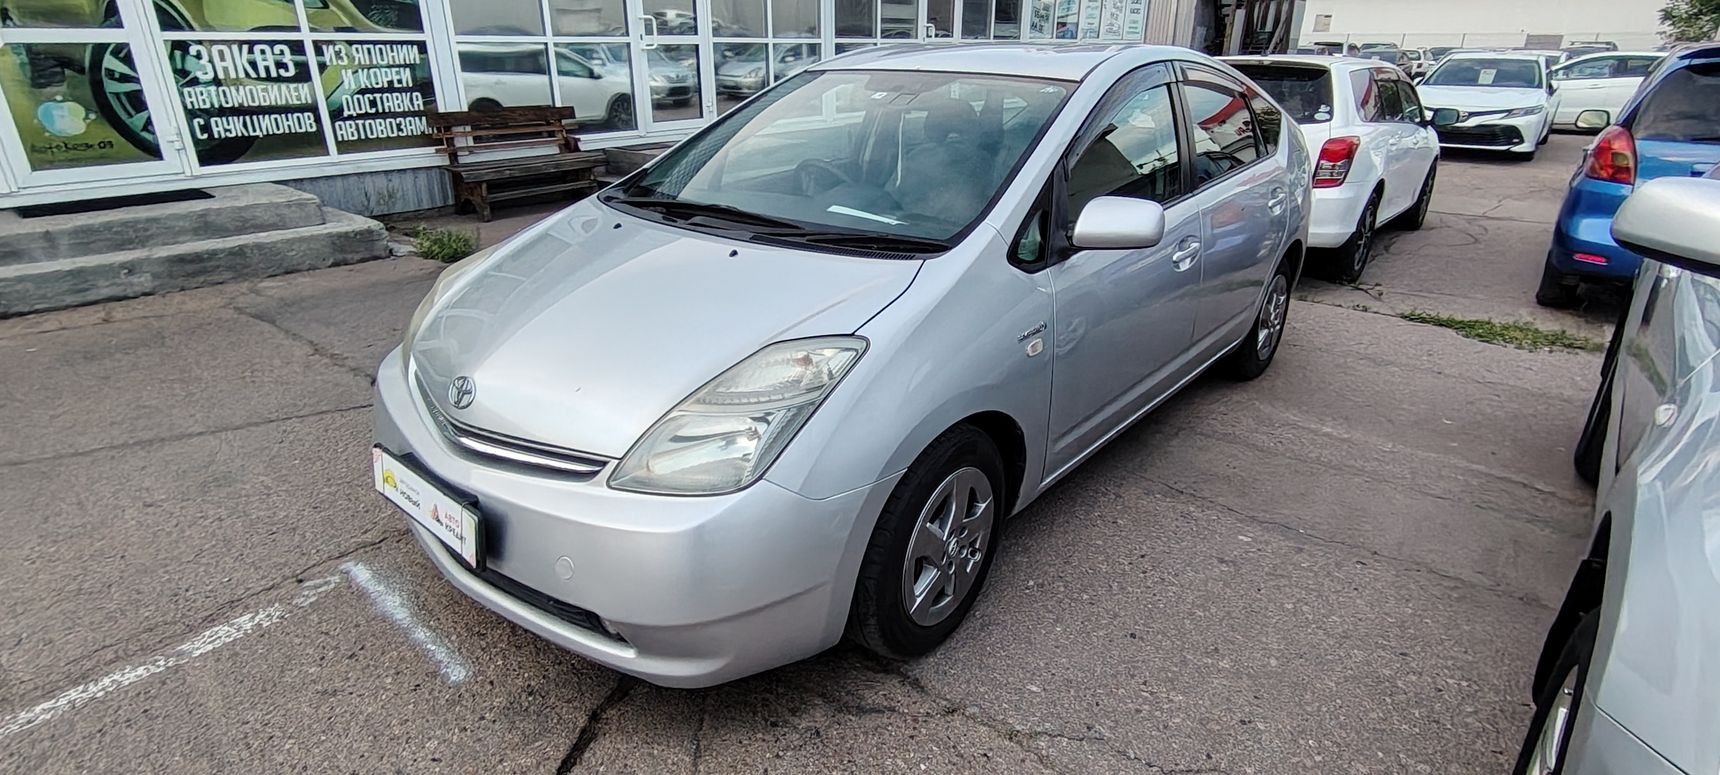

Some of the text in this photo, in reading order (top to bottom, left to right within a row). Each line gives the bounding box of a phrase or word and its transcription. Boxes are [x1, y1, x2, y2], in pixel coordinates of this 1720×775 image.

[189, 44, 296, 82] ЗАКАЗ
[322, 44, 420, 65] ИЗ ЯПОНИИ
[341, 67, 413, 89] И КОРЕИ
[341, 92, 424, 117] ДОСТАВКА
[193, 112, 317, 139] С АУКЦИОНОВ
